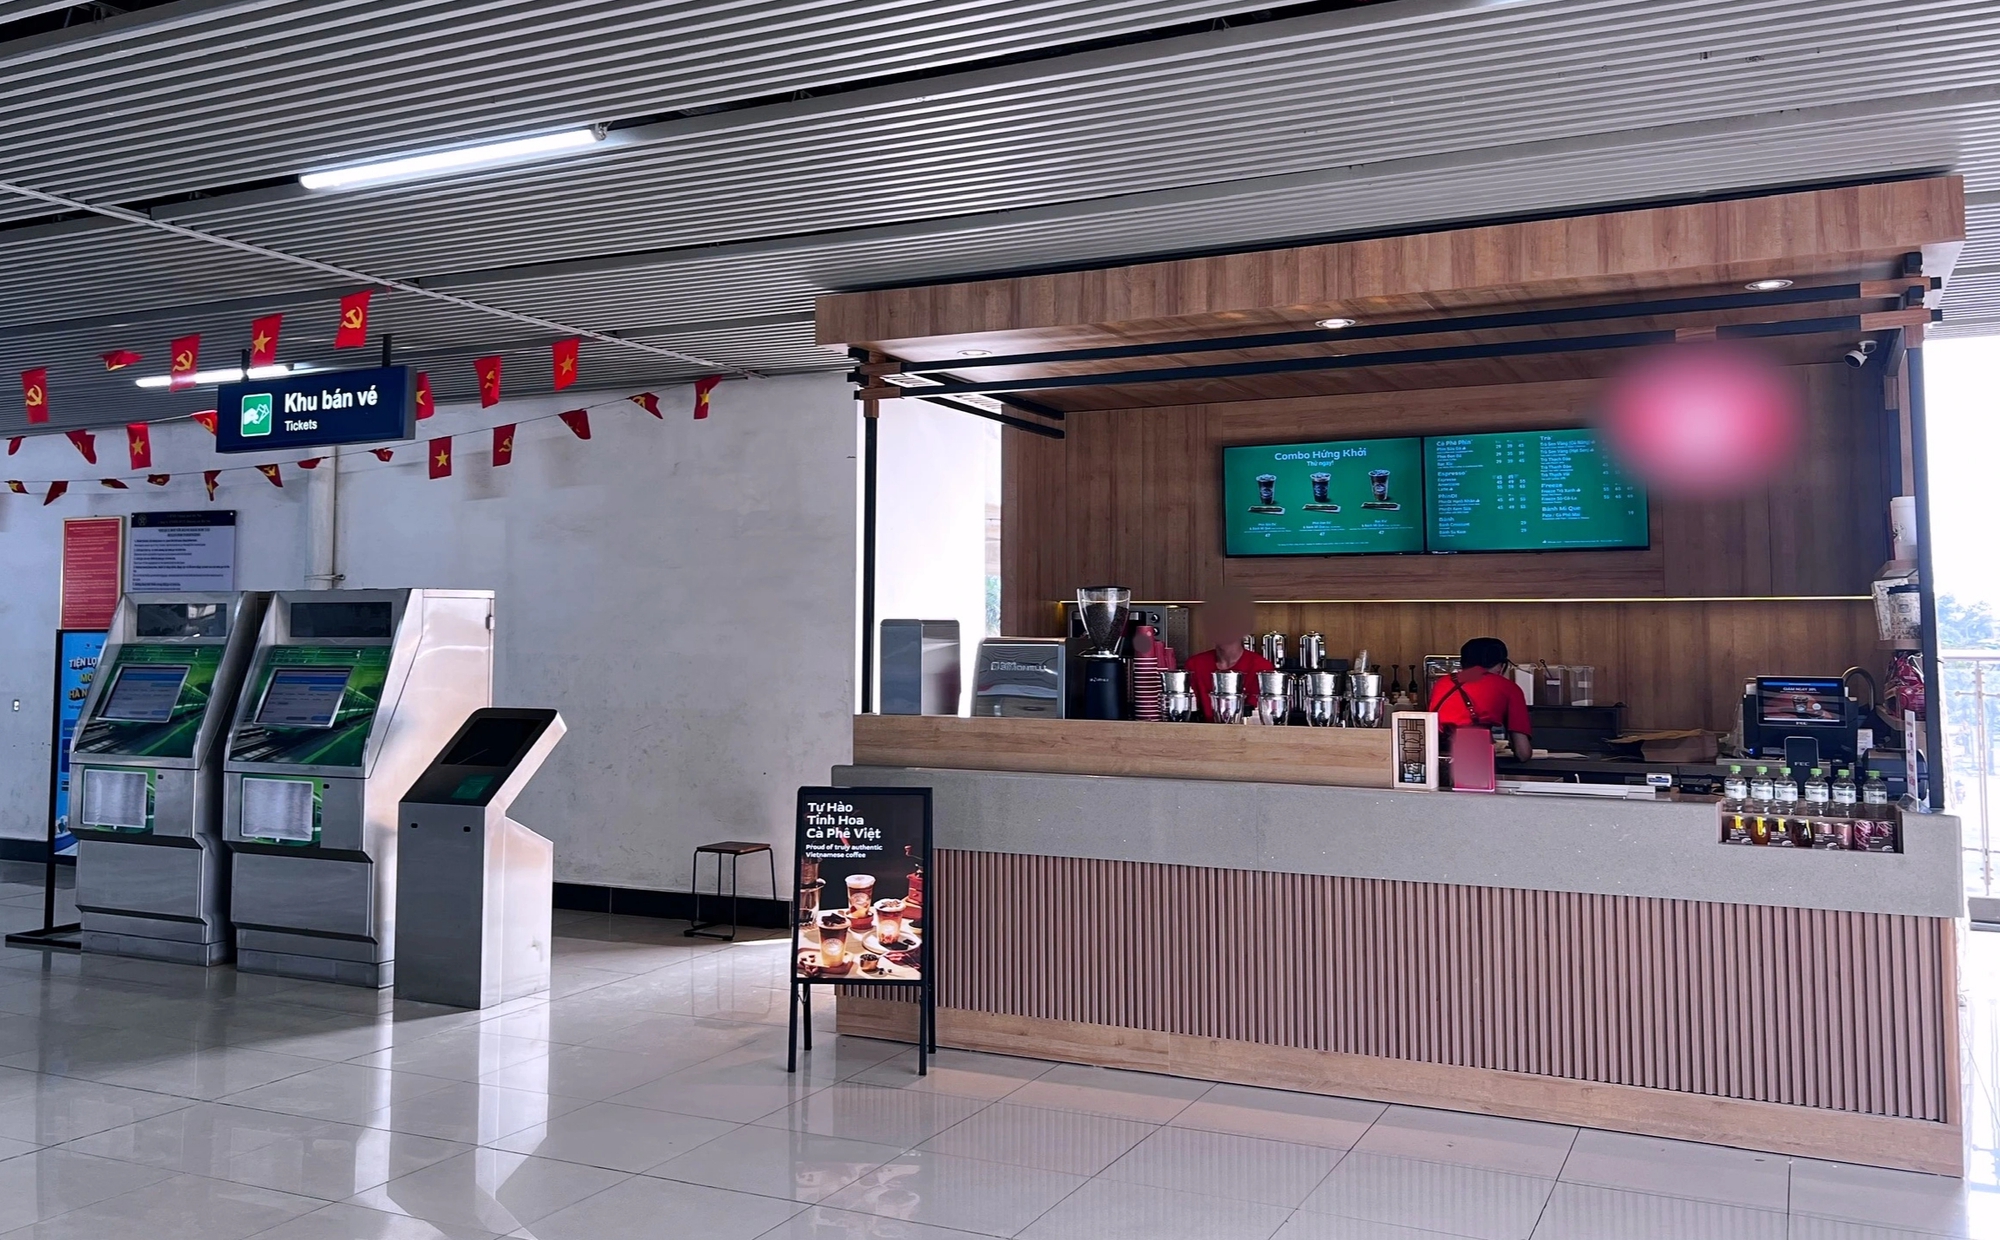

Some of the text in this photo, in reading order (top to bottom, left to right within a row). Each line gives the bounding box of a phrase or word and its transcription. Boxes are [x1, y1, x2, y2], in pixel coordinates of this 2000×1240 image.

[284, 385, 378, 413] Khu bán vé
[284, 419, 318, 431] Tickets
[1275, 448, 1367, 460] Combo Hứng Khởi
[807, 801, 853, 815] Tự Hào
[807, 814, 864, 825] Tinh Hoa
[806, 827, 881, 841] Cà Phê Việt
